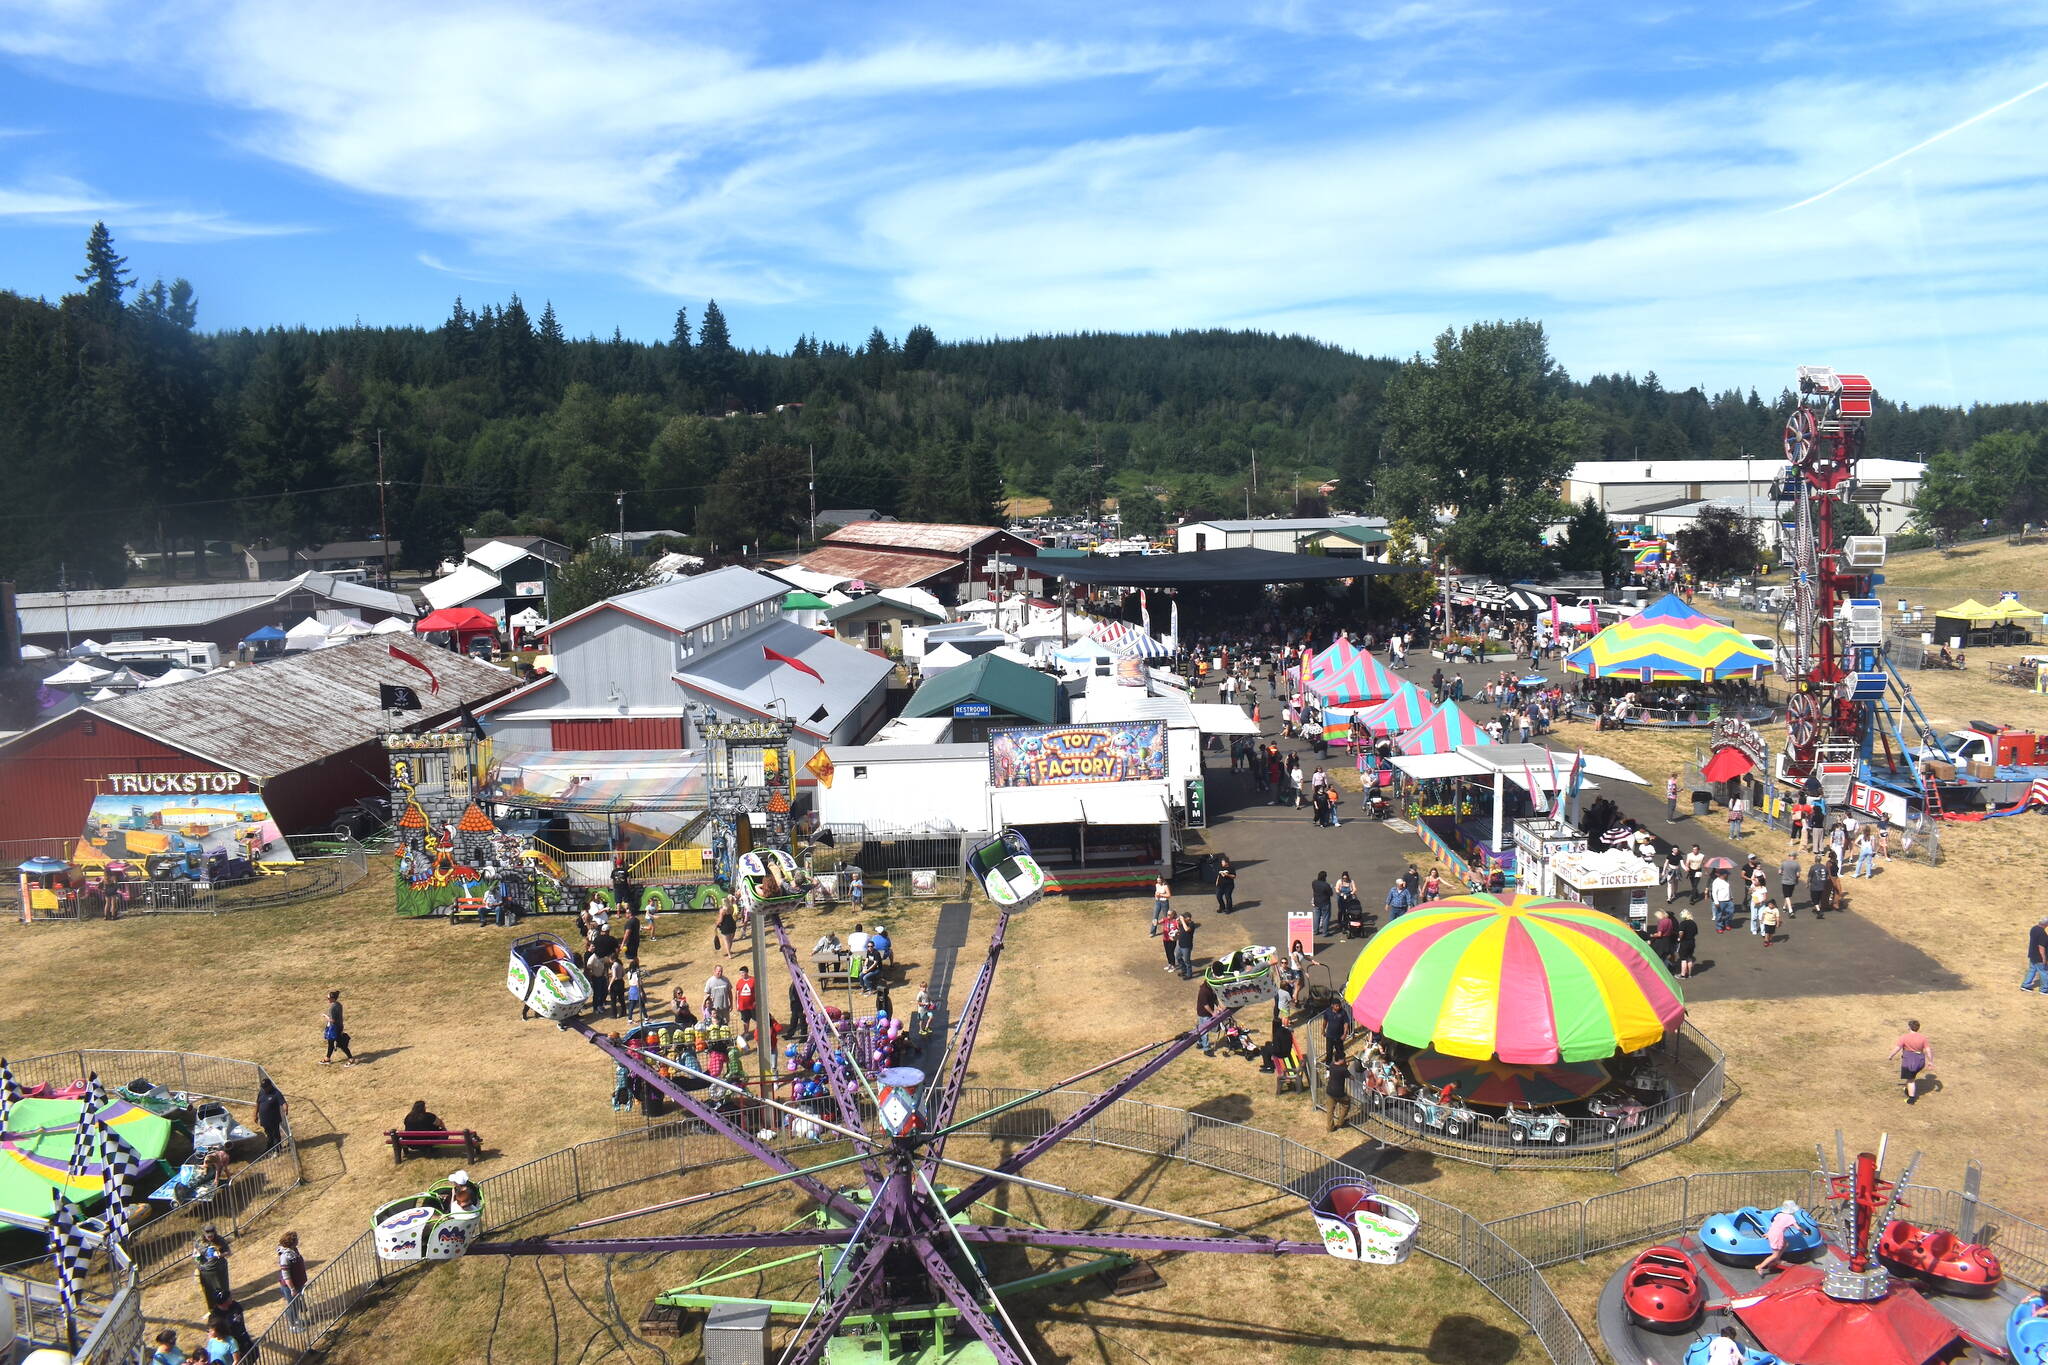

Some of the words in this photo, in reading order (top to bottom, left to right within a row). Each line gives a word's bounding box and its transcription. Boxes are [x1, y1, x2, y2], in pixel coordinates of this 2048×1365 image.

[705, 722, 783, 739] MANIA
[387, 733, 465, 748] CASTLE
[1061, 733, 1092, 749] TOY
[1037, 757, 1116, 779] FACTORY
[108, 771, 241, 793] TRUCKSTOP
[1600, 875, 1638, 886] TICKETS
